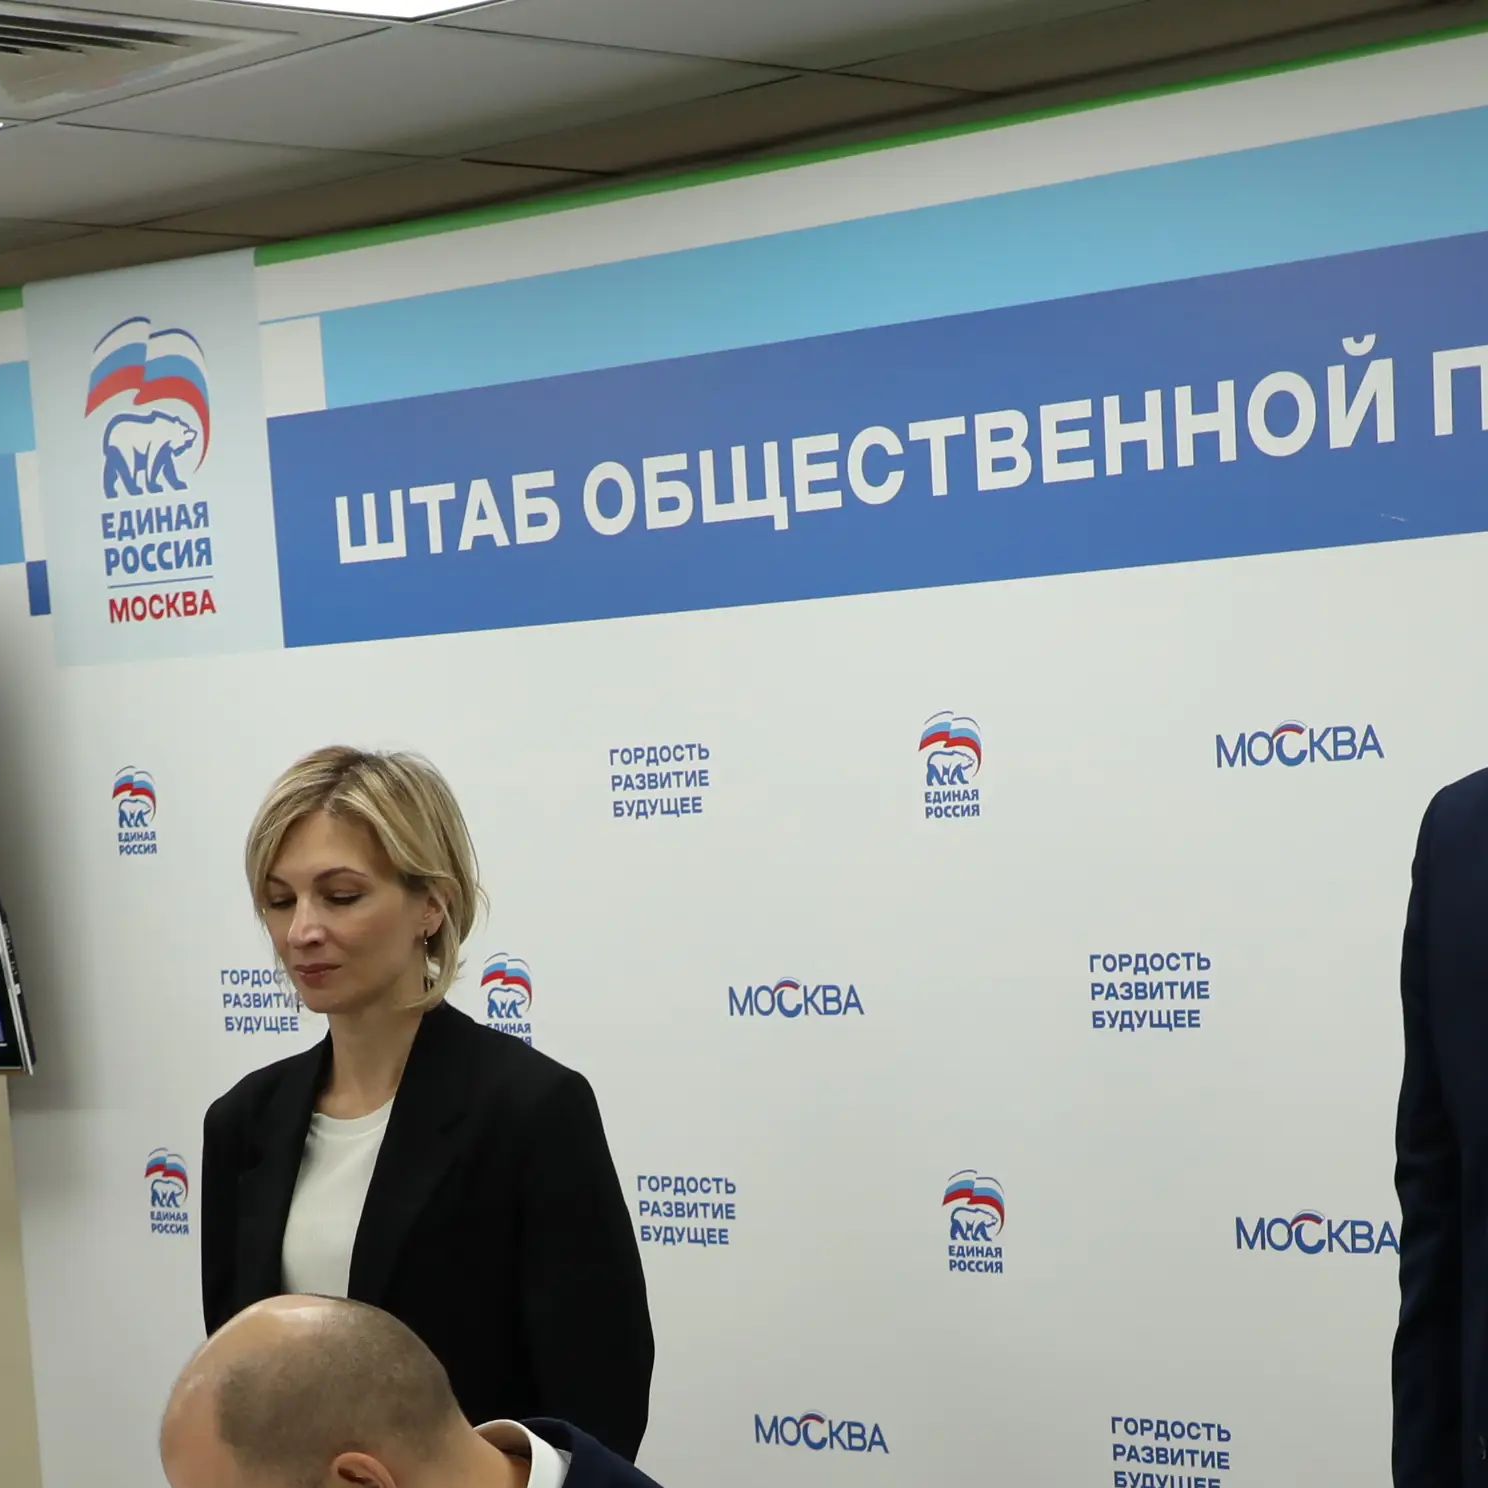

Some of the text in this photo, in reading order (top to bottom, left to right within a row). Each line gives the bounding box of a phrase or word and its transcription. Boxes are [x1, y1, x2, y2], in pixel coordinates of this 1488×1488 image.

[334, 471, 560, 565] ШТАБ
[582, 334, 1396, 537] ОБЩЕСТВЕННОЙ
[101, 501, 209, 541] ЕДИНАЯ
[104, 538, 212, 576] РОССИЯ
[109, 589, 216, 623] МОСКВА
[610, 743, 709, 766] ГОРДОСТЬ
[1216, 720, 1384, 768] МОСКВА
[612, 770, 709, 791] РАЗВИТИЕ
[613, 796, 702, 819] БУДУЩЕЕ
[925, 789, 979, 804] ЕДИНАЯ
[925, 804, 980, 819] РОССИЯ
[118, 832, 156, 843] ЕДИНАЯ
[119, 844, 157, 855] РОССИЯ
[1090, 952, 1211, 975] ГОРДОСТЬ
[727, 977, 864, 1018] МОСКВА
[1091, 981, 1209, 1000] РАЗВИТИЕ
[225, 1016, 298, 1034] БУДУЩЕЕ
[1092, 1010, 1200, 1032] БУДУЩЕЕ
[637, 1175, 736, 1196] ГОРДОСТЬ
[150, 1212, 188, 1222] ЕДИНАЯ
[639, 1201, 735, 1220] РАЗВИТИЕ
[151, 1223, 189, 1234] РОССИЯ
[641, 1225, 729, 1247] БУДУЩЕЕ
[1235, 1209, 1400, 1254] МОСКВА
[949, 1245, 1002, 1258] ЕДИНАЯ
[949, 1259, 1003, 1273] РОССИЯ
[754, 1410, 888, 1454] МОСКВА
[1112, 1417, 1231, 1442] ГОРДОСТЬ
[1113, 1444, 1230, 1469] РАЗВИТИЕ
